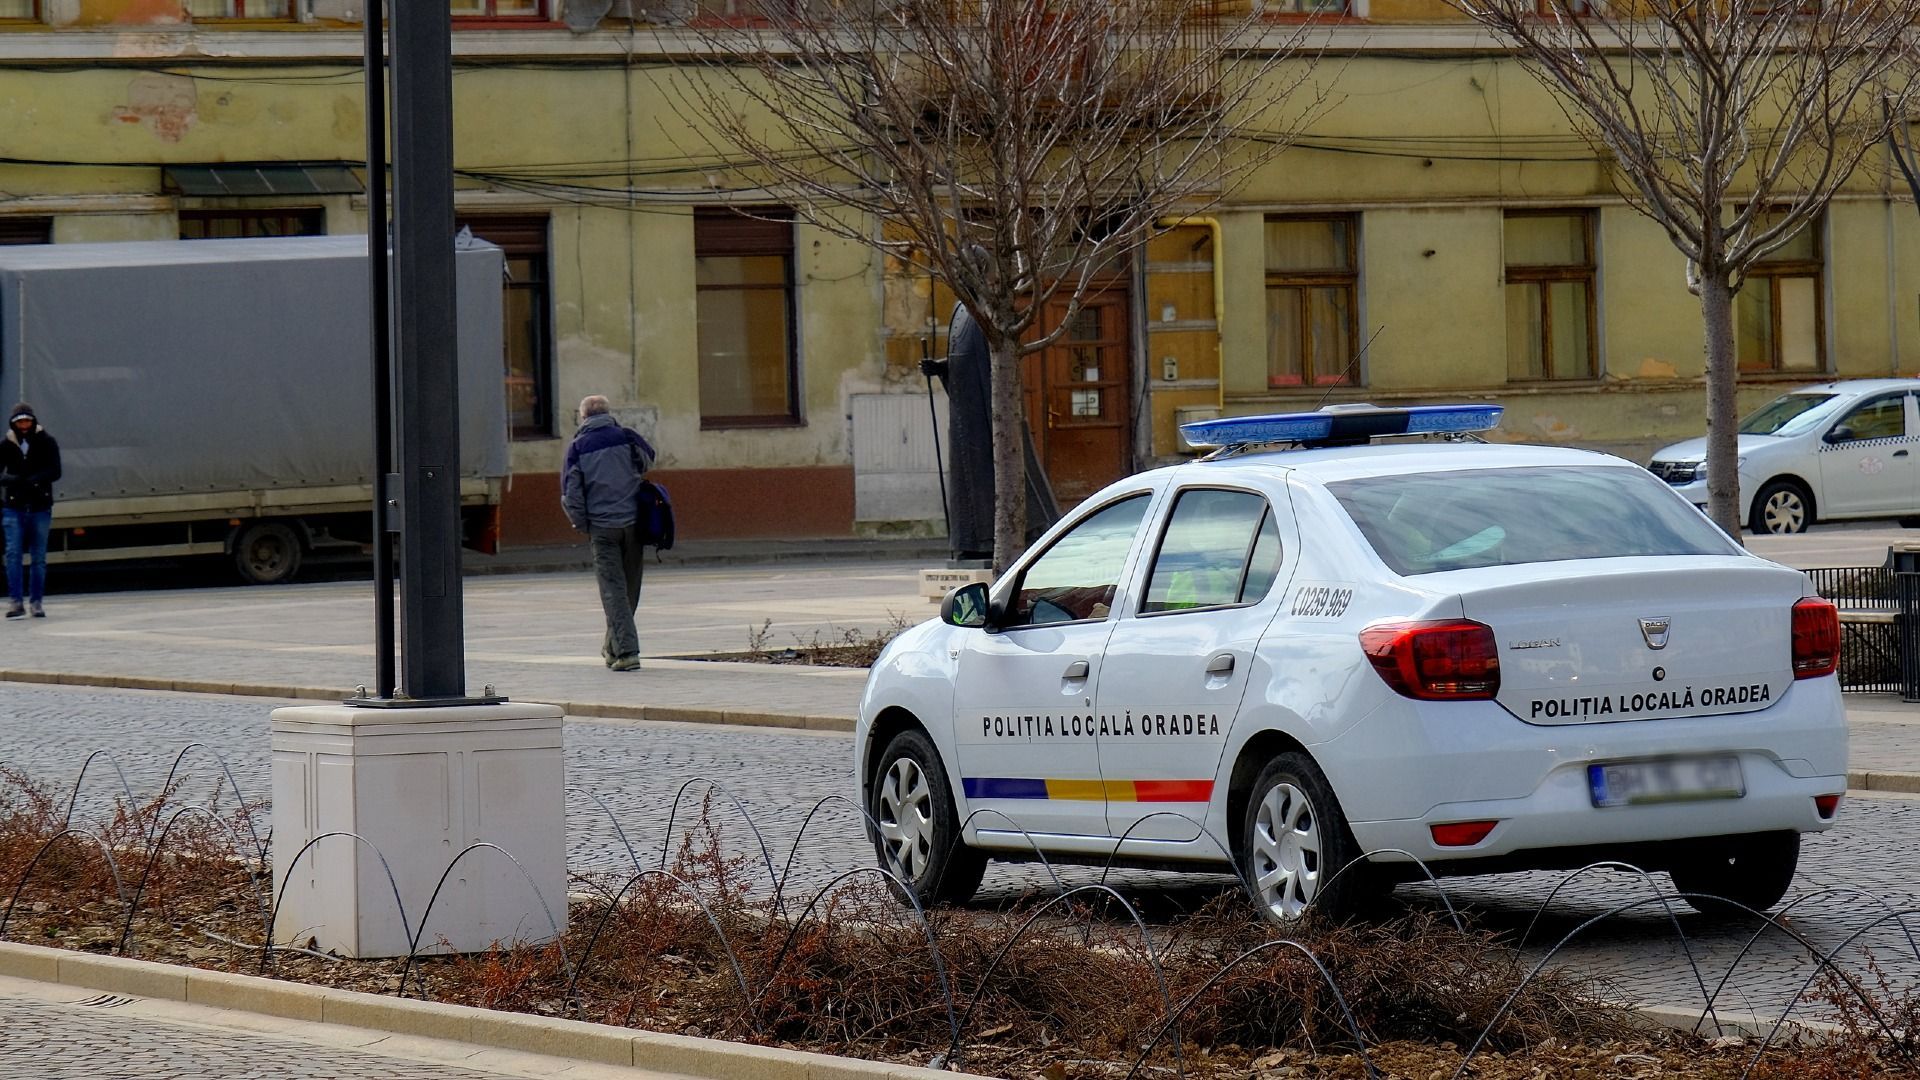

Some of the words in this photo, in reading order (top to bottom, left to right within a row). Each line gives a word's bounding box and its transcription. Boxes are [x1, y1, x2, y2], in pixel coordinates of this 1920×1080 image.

[1298, 586, 1330, 616] 0259
[1325, 588, 1353, 617] 969
[1509, 637, 1561, 650] LOGAN
[1620, 686, 1695, 713] LOCALĂ
[1700, 683, 1770, 706] ORADEA
[1060, 709, 1135, 736] LOCALĂ
[1141, 714, 1220, 736] ORADEA
